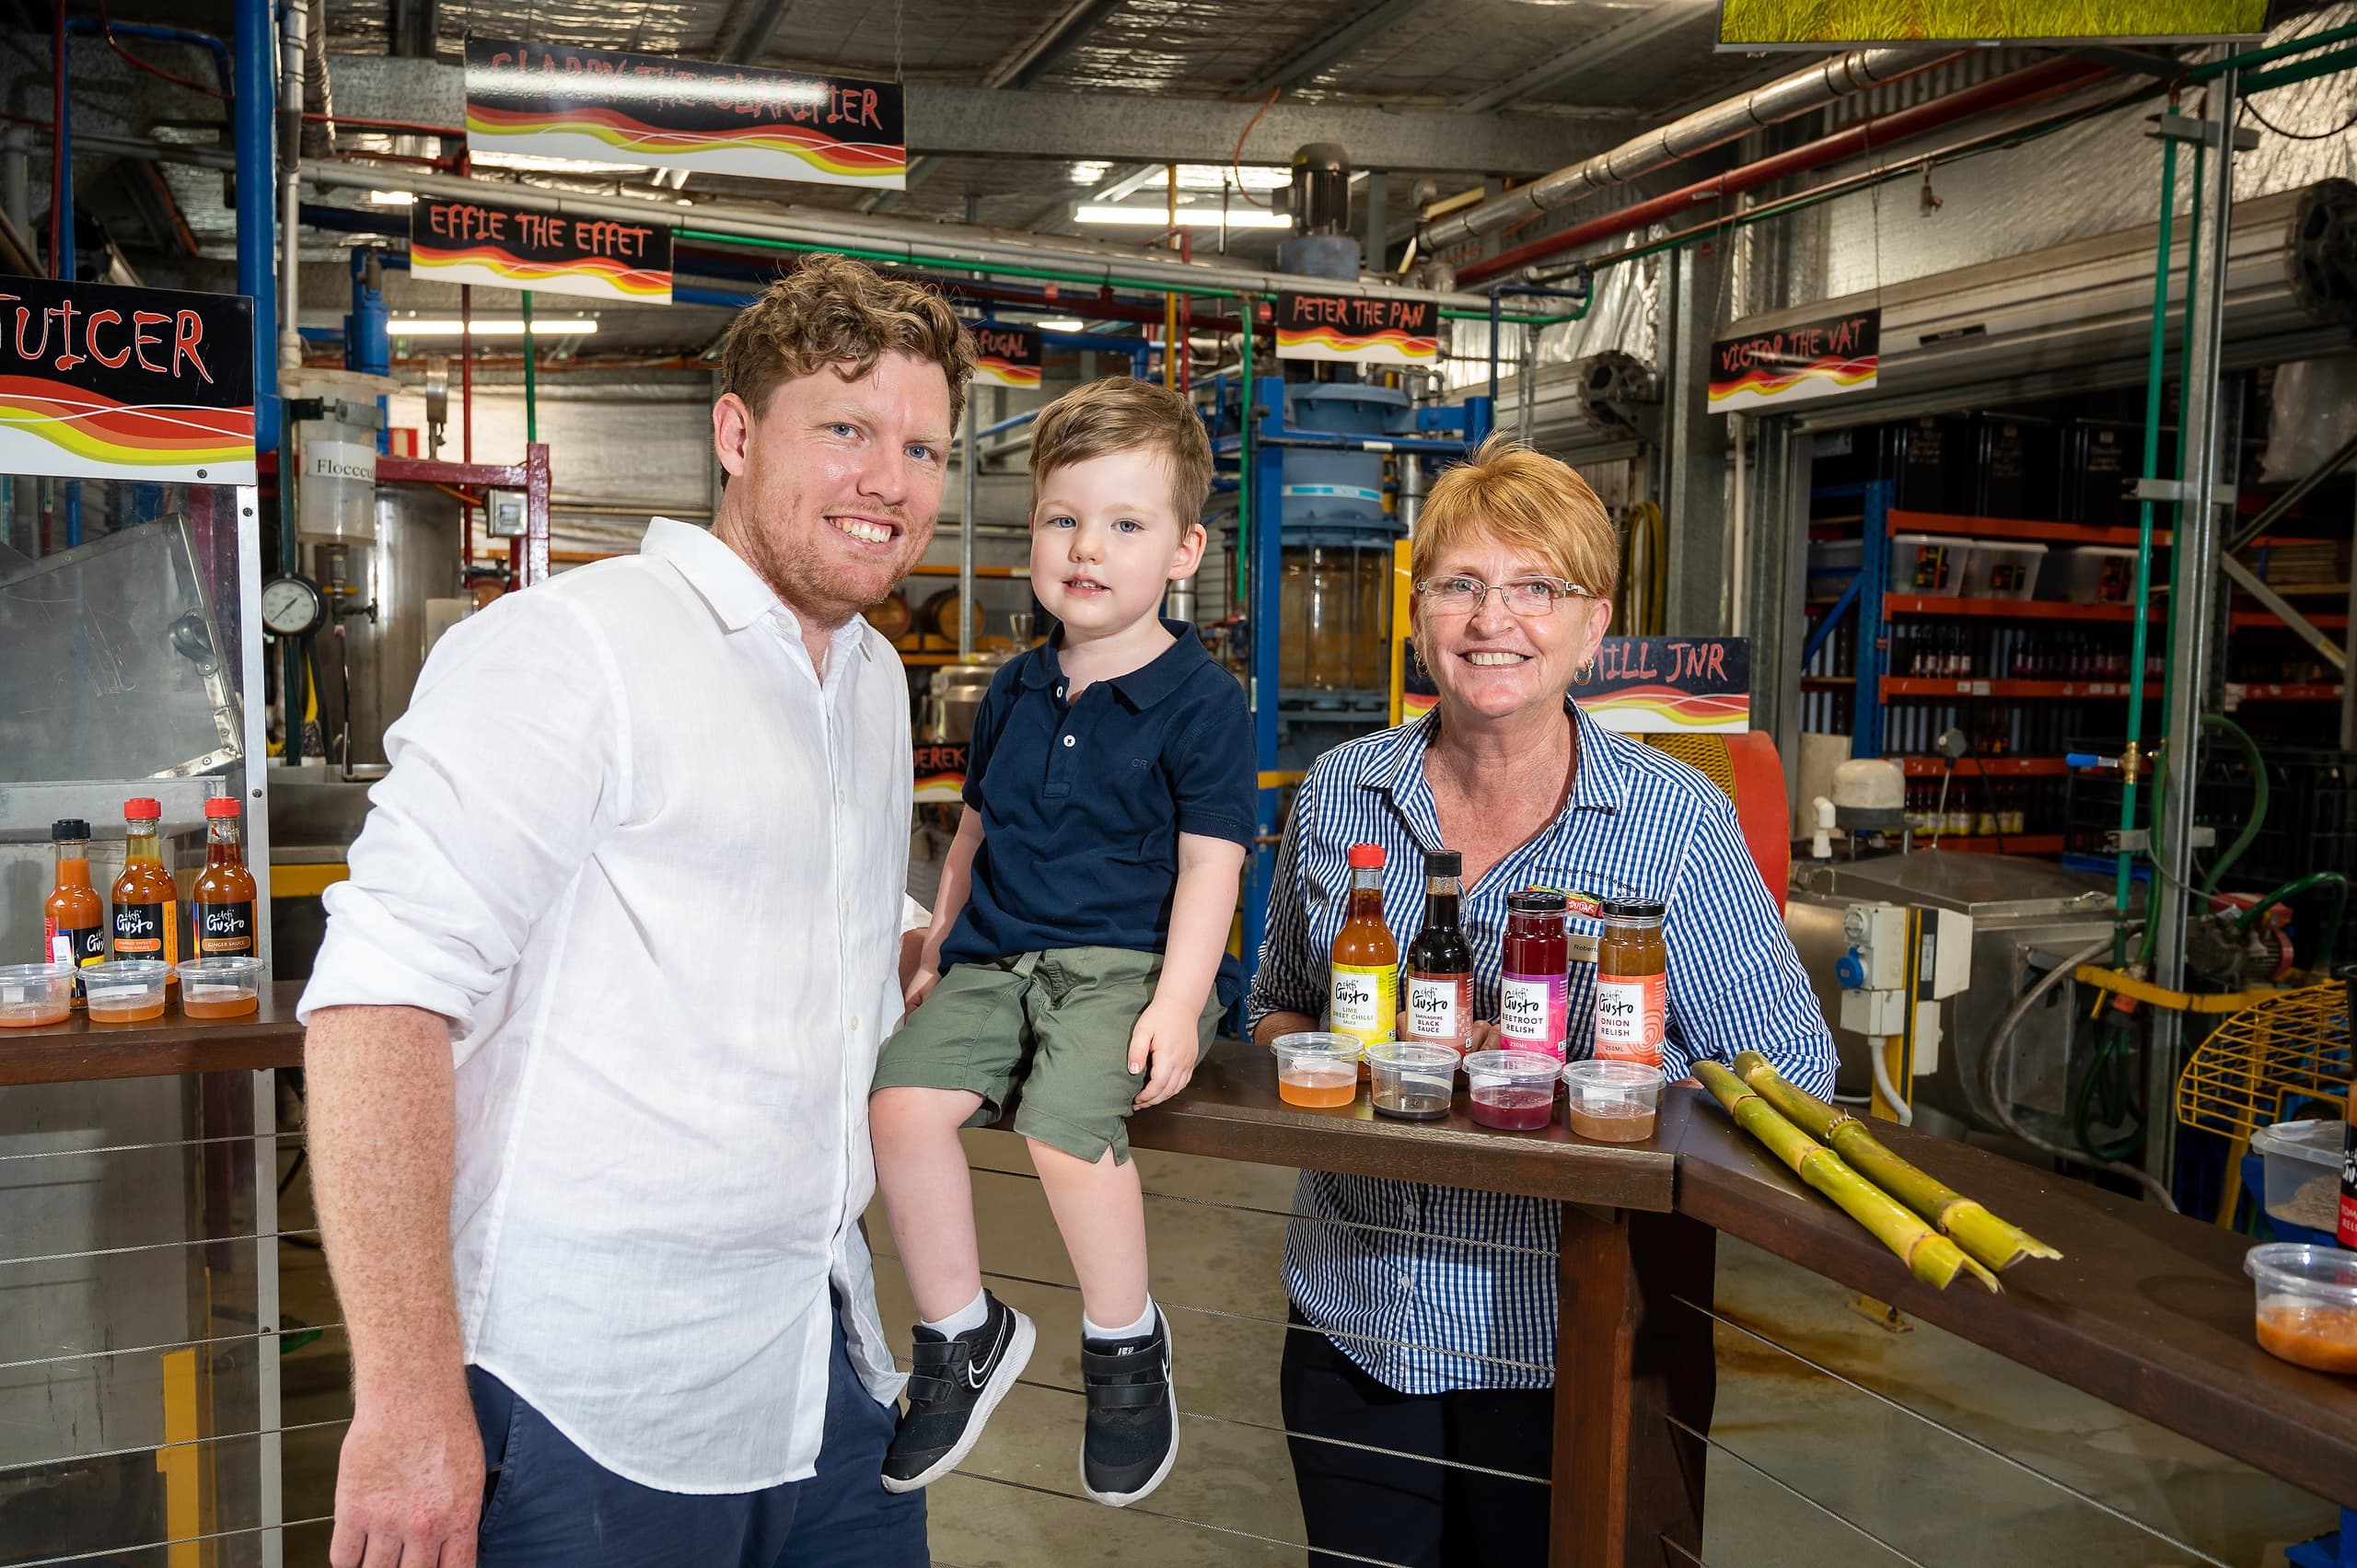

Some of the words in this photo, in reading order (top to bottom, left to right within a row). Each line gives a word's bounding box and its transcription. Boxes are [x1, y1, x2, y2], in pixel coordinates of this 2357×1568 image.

[430, 203, 508, 240] EFFIE
[514, 212, 567, 250] THE
[575, 221, 654, 258] EFFET
[1293, 295, 1350, 326] PETER
[1353, 299, 1386, 329] THE
[1388, 301, 1426, 330] PAN
[1721, 333, 1783, 372] VICTOR
[1788, 327, 1824, 357] THE
[1828, 318, 1867, 354] VAT
[1666, 642, 1728, 683] JNR
[116, 913, 154, 934] Gusto
[207, 913, 245, 934] Gusto
[1573, 944, 1597, 953] Robert
[1335, 981, 1369, 1005] Gusto
[1411, 990, 1448, 1013] Gusto
[1504, 990, 1539, 1015] Gusto
[1598, 993, 1634, 1017] Gusto
[1351, 1013, 1374, 1021] CHILLI
[1502, 1013, 1544, 1025] BEETROOT
[1600, 1017, 1630, 1027] ONION
[1505, 1023, 1535, 1034] RELISH
[1600, 1027, 1630, 1037] RELISH
